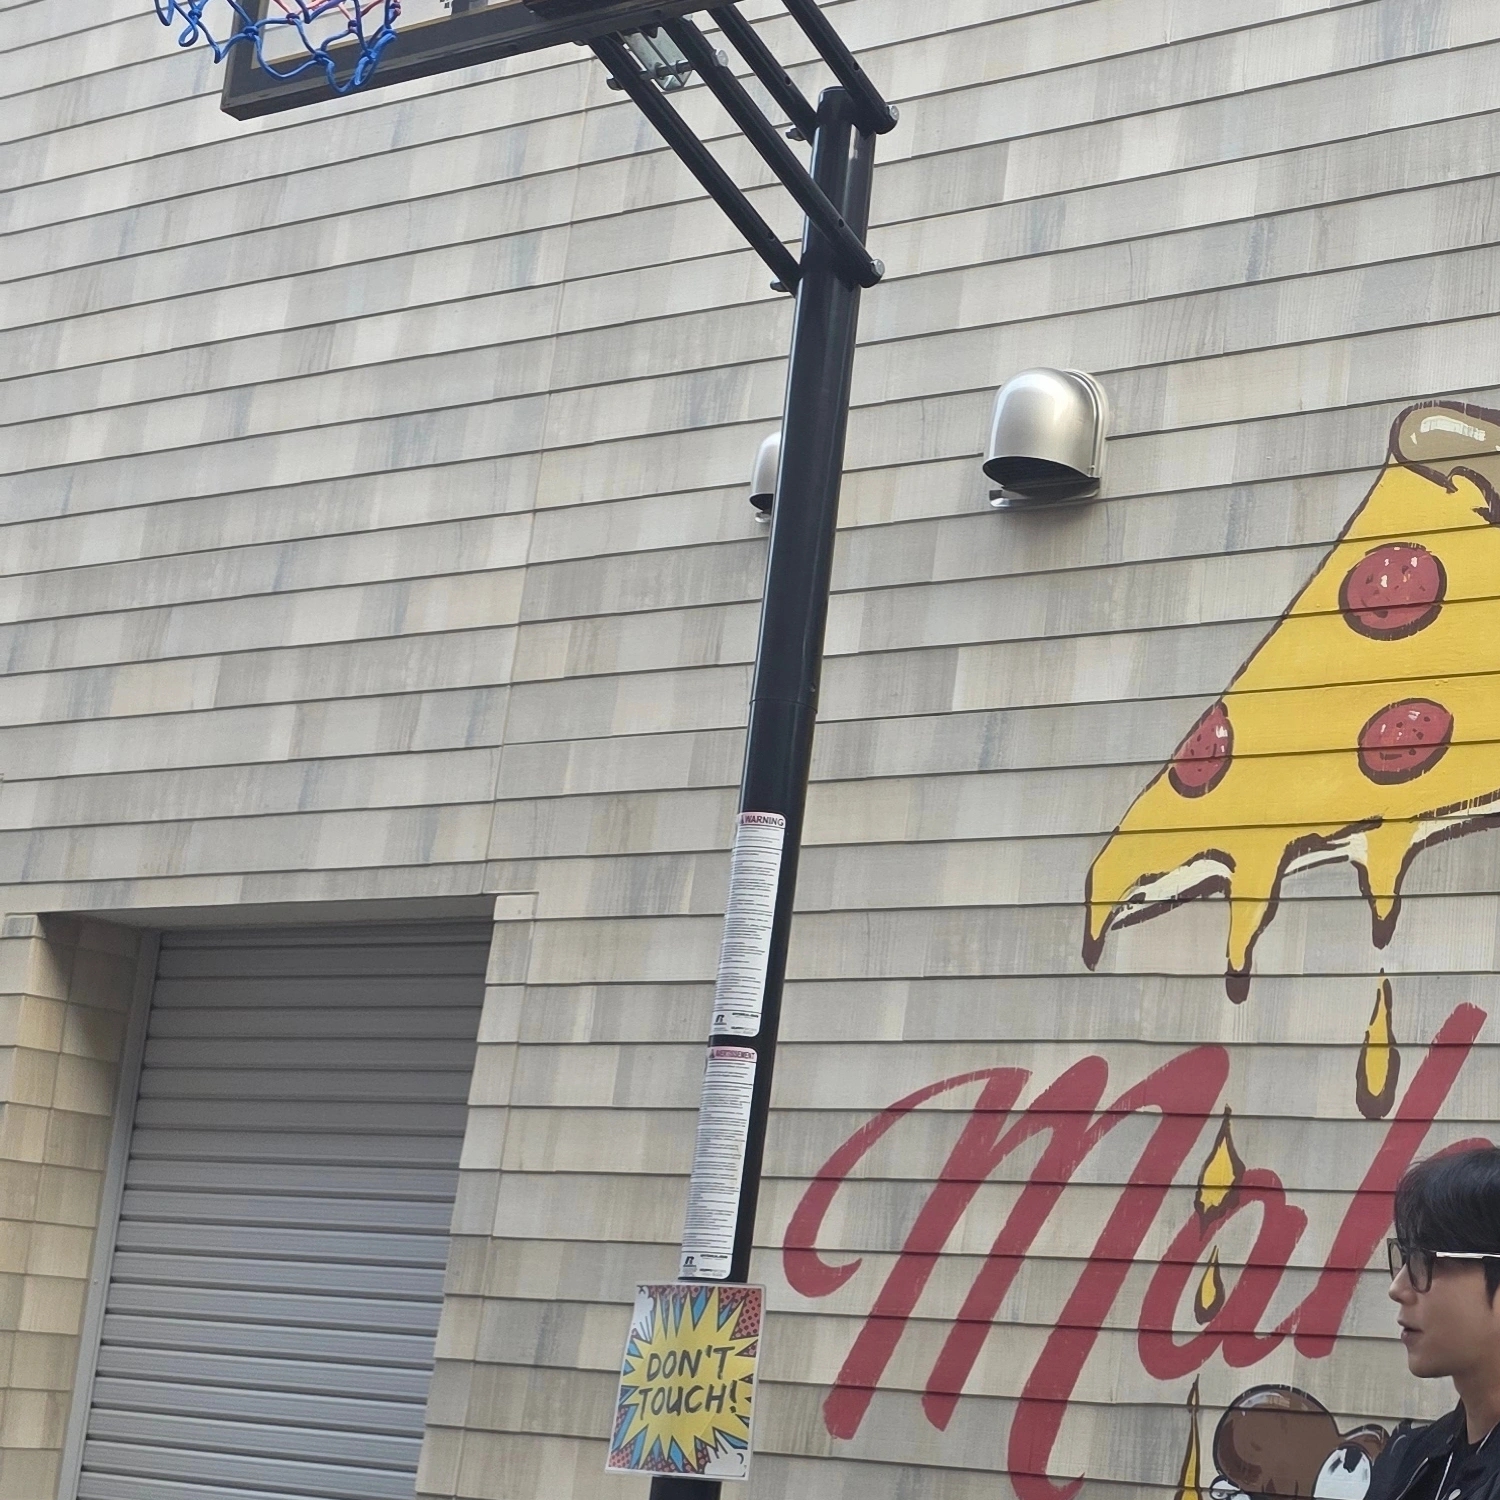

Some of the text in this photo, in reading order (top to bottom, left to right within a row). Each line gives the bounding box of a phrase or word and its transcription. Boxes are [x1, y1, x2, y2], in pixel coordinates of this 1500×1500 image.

[744, 815, 785, 827] WARNING
[646, 1344, 736, 1382] DON'T
[638, 1380, 738, 1421] TOUCH!
